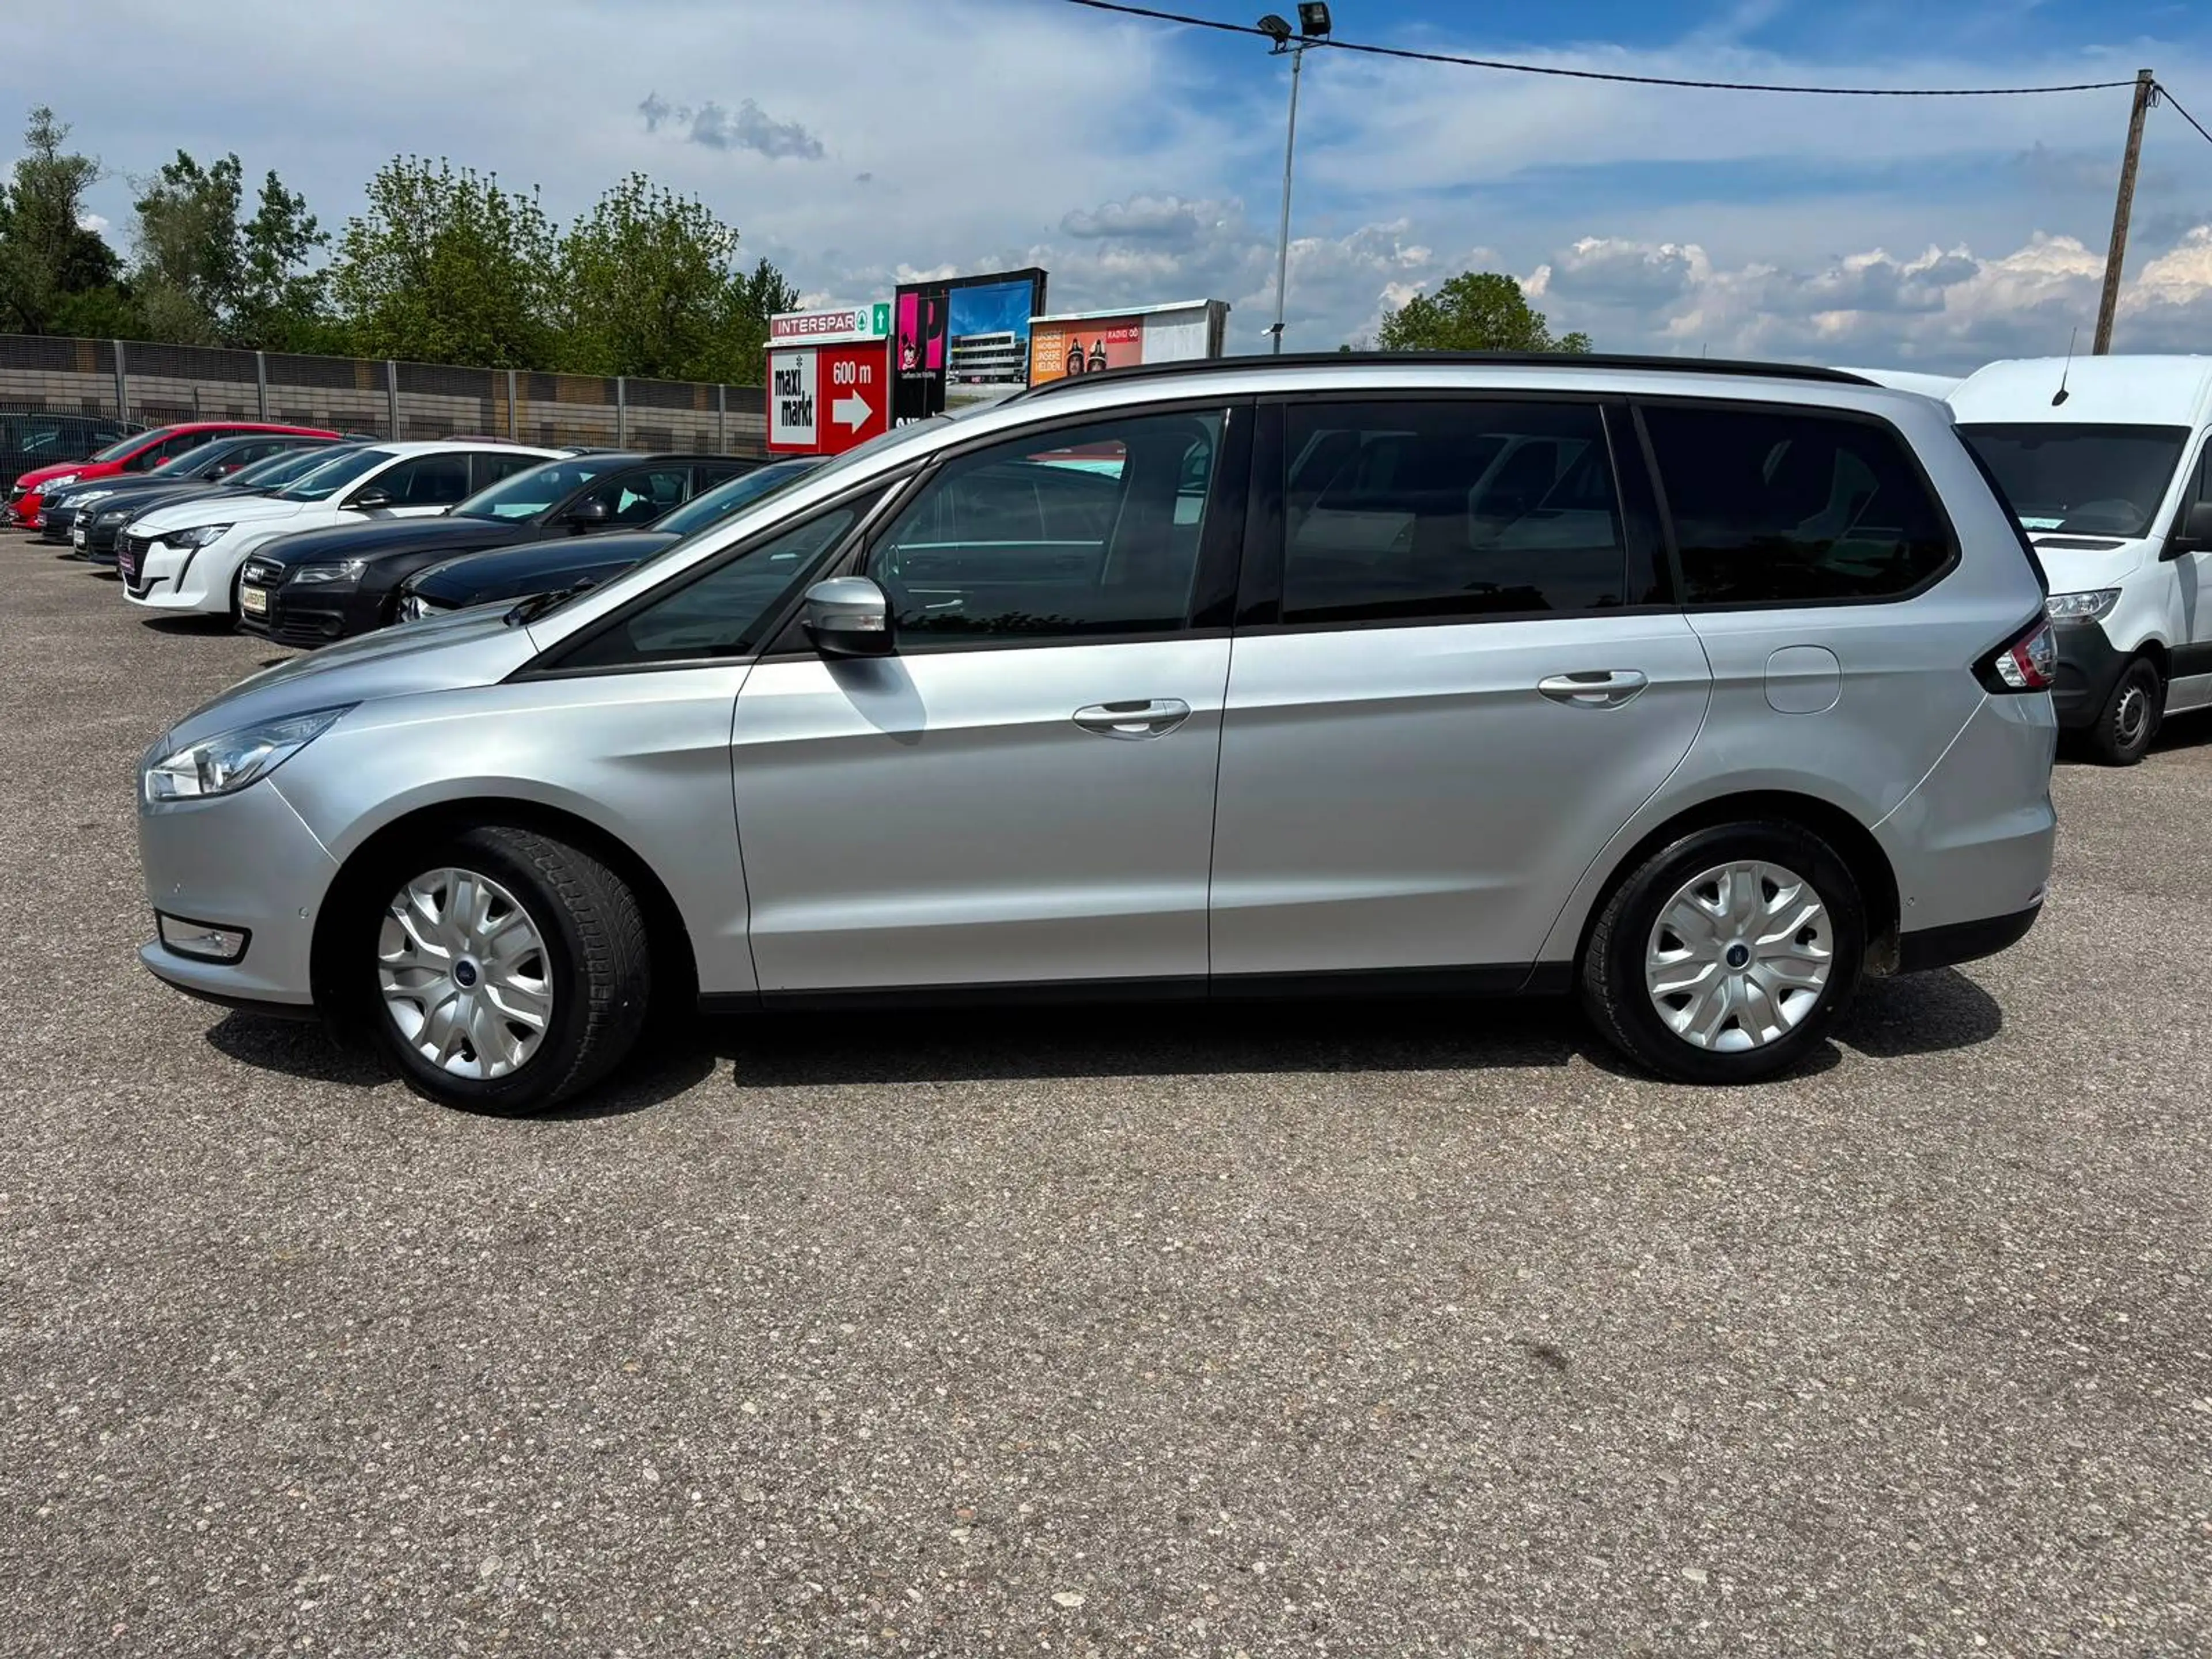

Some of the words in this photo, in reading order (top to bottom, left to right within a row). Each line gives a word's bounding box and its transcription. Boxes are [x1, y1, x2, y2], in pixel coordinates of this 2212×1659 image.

[778, 315, 854, 334] INTERSPAR
[775, 356, 802, 396] maxi
[833, 361, 856, 385] 600
[859, 364, 872, 385] m
[781, 390, 813, 427] markt
